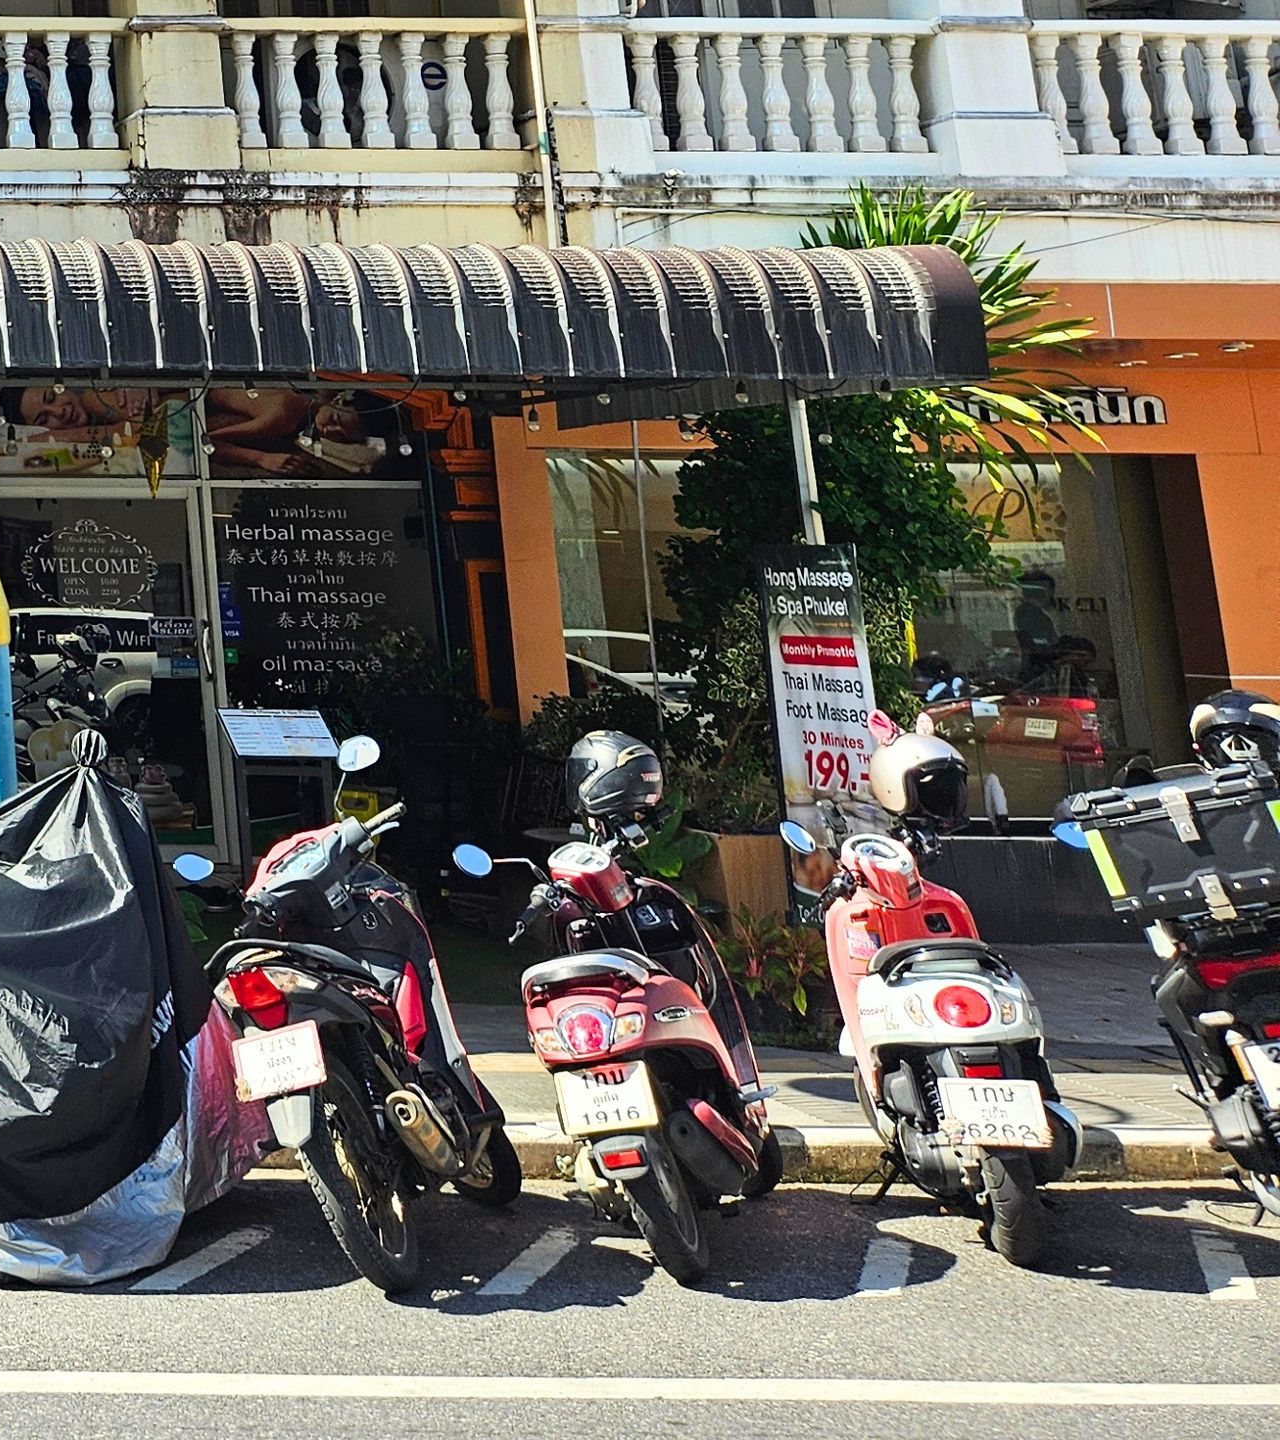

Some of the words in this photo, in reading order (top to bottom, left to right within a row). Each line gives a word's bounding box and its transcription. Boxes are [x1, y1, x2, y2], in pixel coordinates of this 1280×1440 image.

[224, 524, 295, 541] Herbal
[301, 528, 394, 546] massage
[53, 544, 76, 553] Have
[109, 545, 125, 556] day
[39, 558, 141, 574] WELCOME
[63, 577, 86, 586] OPEN
[763, 566, 797, 591] Hong
[796, 567, 854, 592] Massage
[64, 587, 90, 596] CLOSE
[247, 586, 291, 604] Thai
[297, 589, 387, 608] massage
[776, 595, 804, 619] Spa
[803, 595, 849, 616] Phuket
[276, 611, 364, 630] 泰式按摩
[781, 642, 816, 658] Monthly
[817, 644, 855, 658] Promotio
[262, 654, 287, 671] oil
[782, 670, 809, 691] Thai
[811, 672, 864, 699] Massag
[785, 699, 814, 720] Foot
[816, 701, 869, 729] Massag
[802, 730, 817, 745] 30
[820, 731, 865, 750] Minutes
[856, 753, 873, 765] TH
[582, 1106, 640, 1126] 1916
